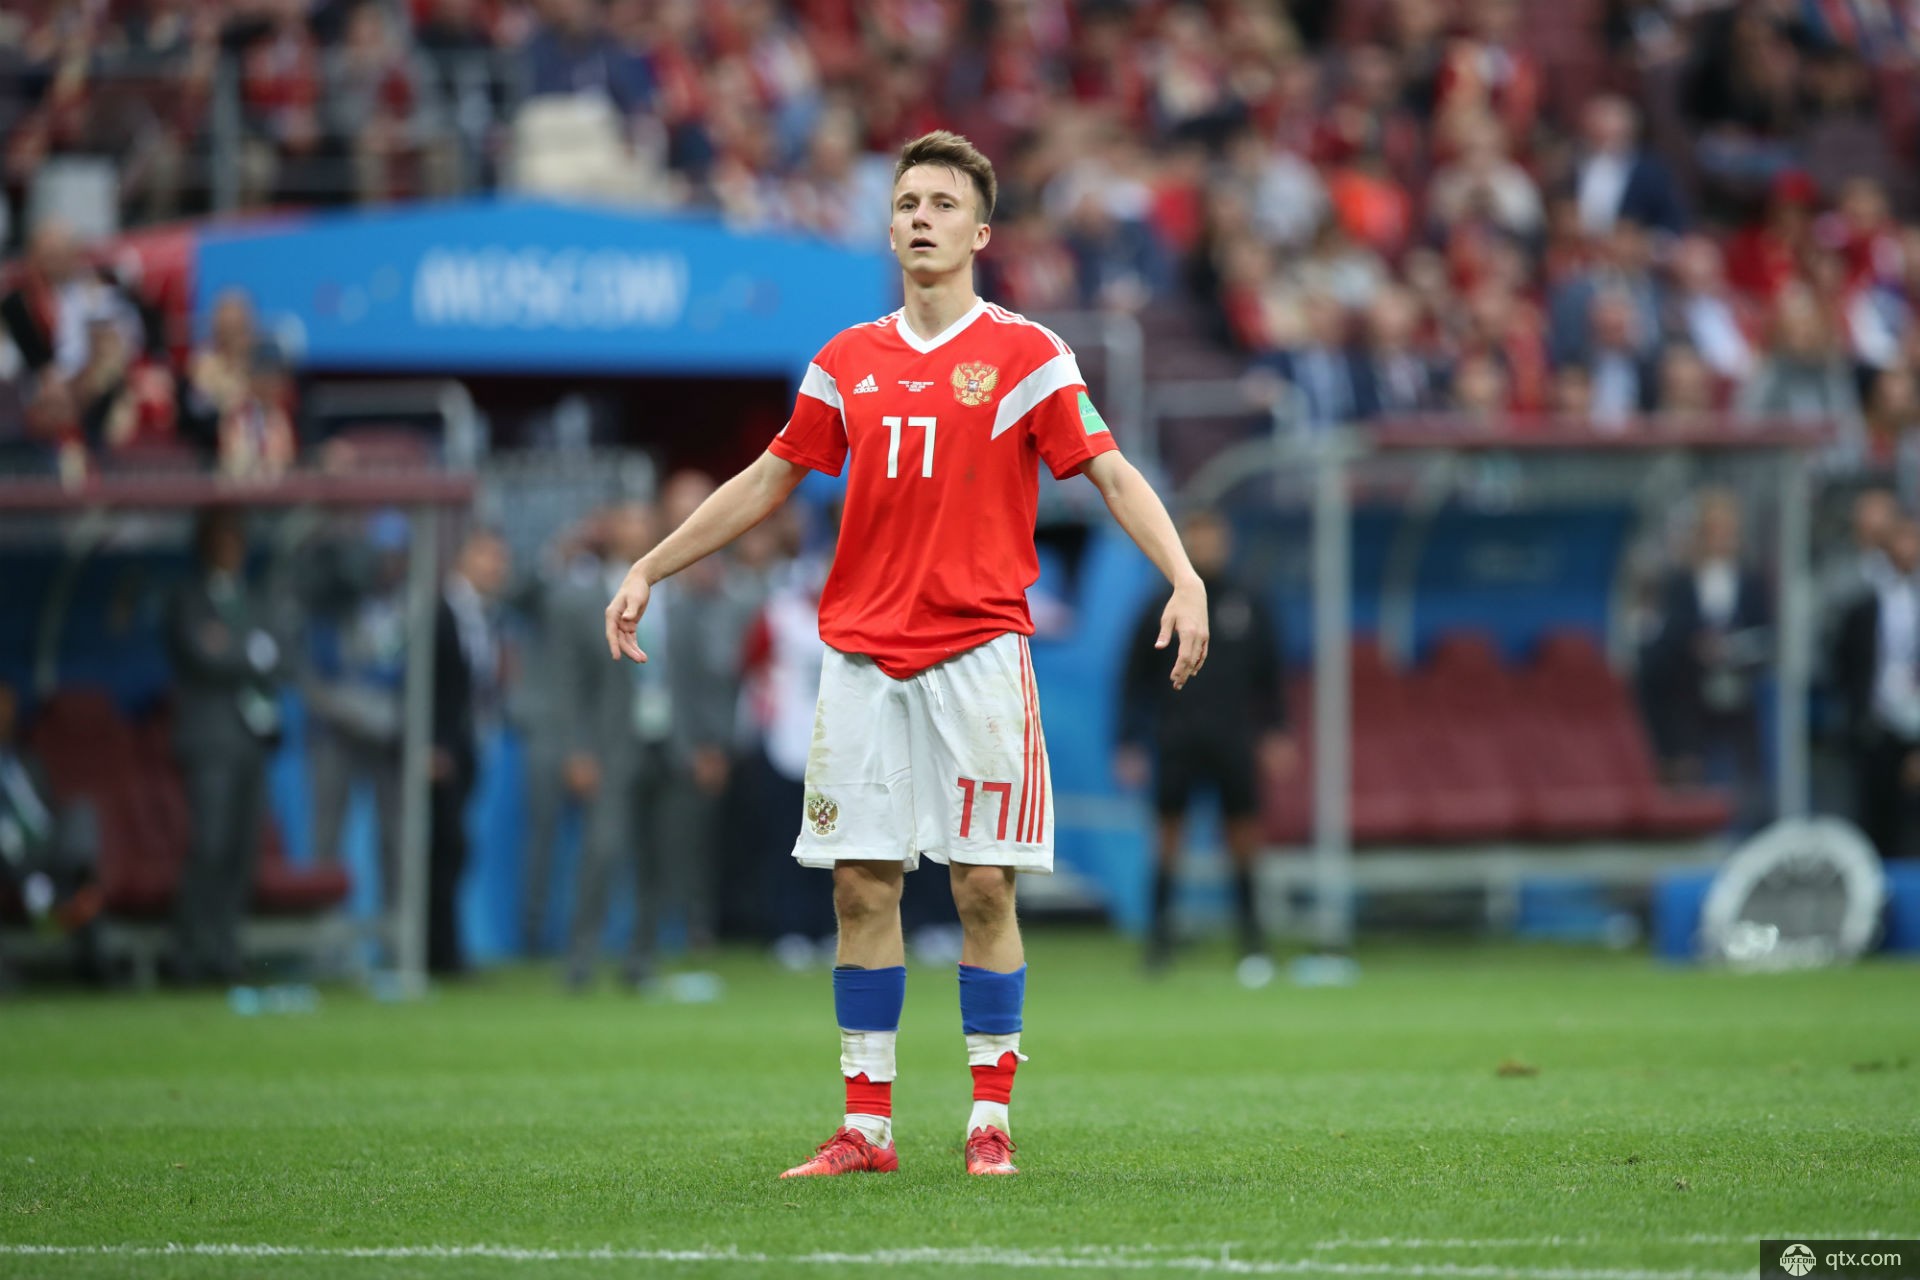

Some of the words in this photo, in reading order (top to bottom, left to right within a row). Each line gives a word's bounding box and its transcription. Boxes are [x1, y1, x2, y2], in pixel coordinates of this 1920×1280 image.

[414, 248, 688, 328] MOSCOW
[853, 386, 879, 395] adidas
[882, 416, 937, 478] 17
[957, 777, 1012, 840] 17
